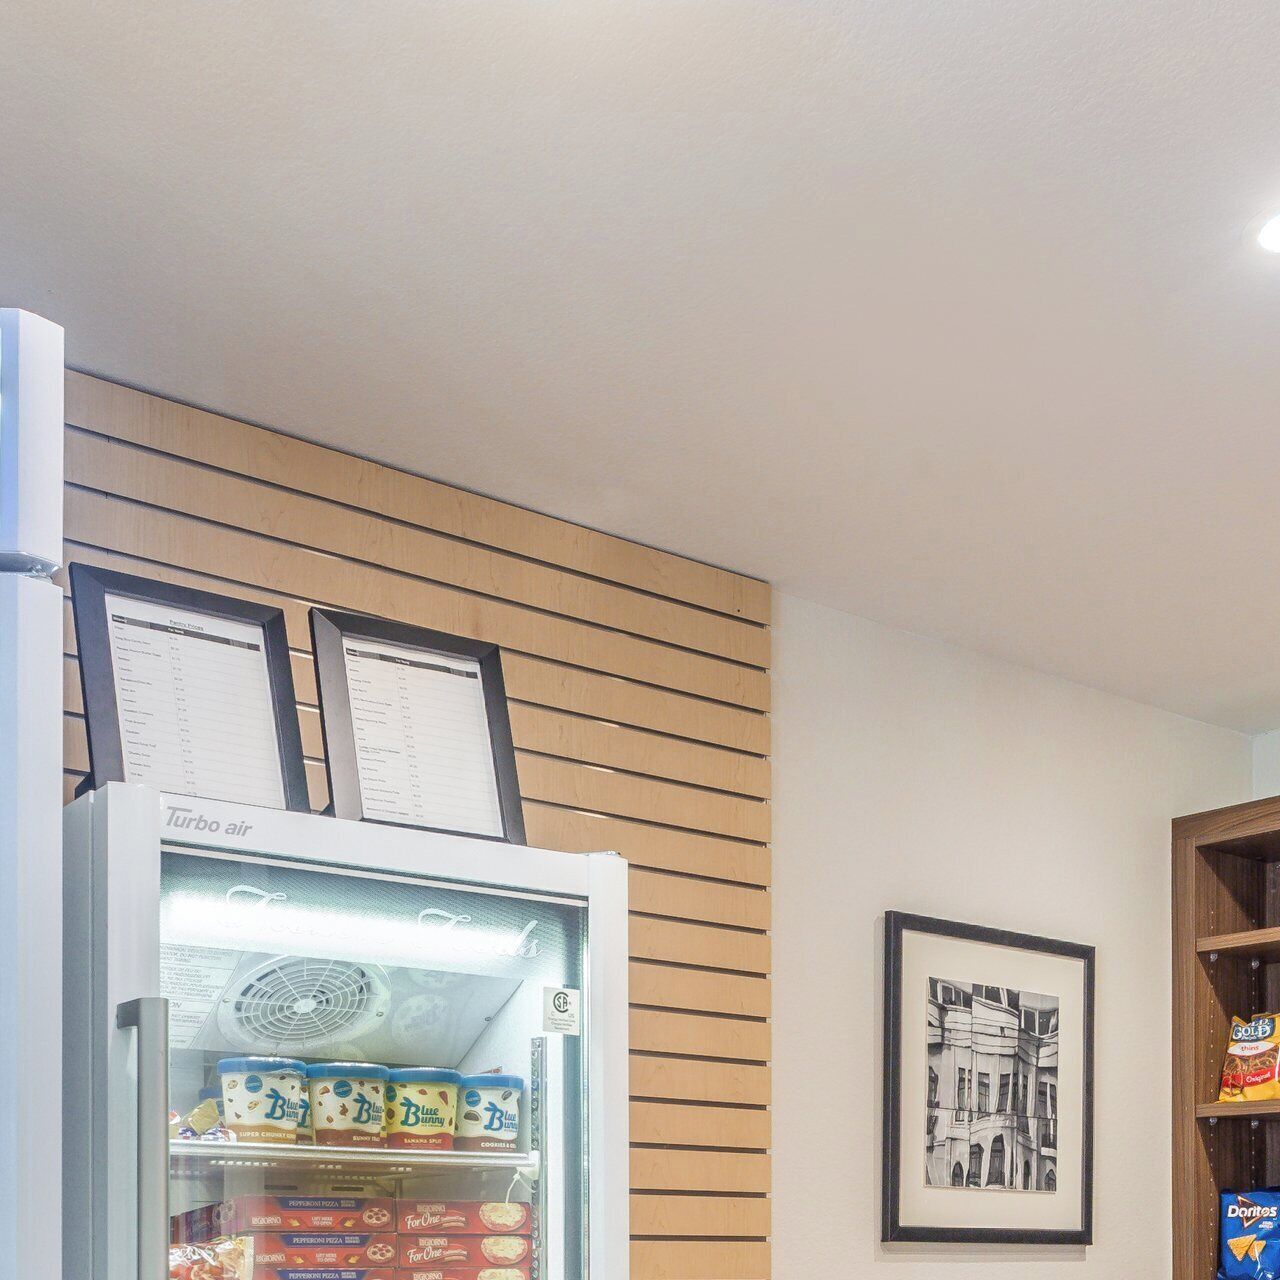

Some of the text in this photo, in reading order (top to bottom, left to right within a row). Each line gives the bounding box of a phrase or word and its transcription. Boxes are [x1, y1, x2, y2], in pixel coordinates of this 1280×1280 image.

[165, 806, 253, 838] Turbo air
[1232, 1024, 1271, 1041] GOLD
[1241, 1044, 1260, 1052] thins
[1246, 1071, 1271, 1084] Original
[260, 1131, 287, 1139] CHUNKY
[288, 1200, 321, 1208] PEPPERONI
[1227, 1204, 1278, 1218] Doritos
[421, 1212, 440, 1227] One
[423, 1246, 442, 1260] One
[288, 1272, 321, 1280] PEPPERONI
